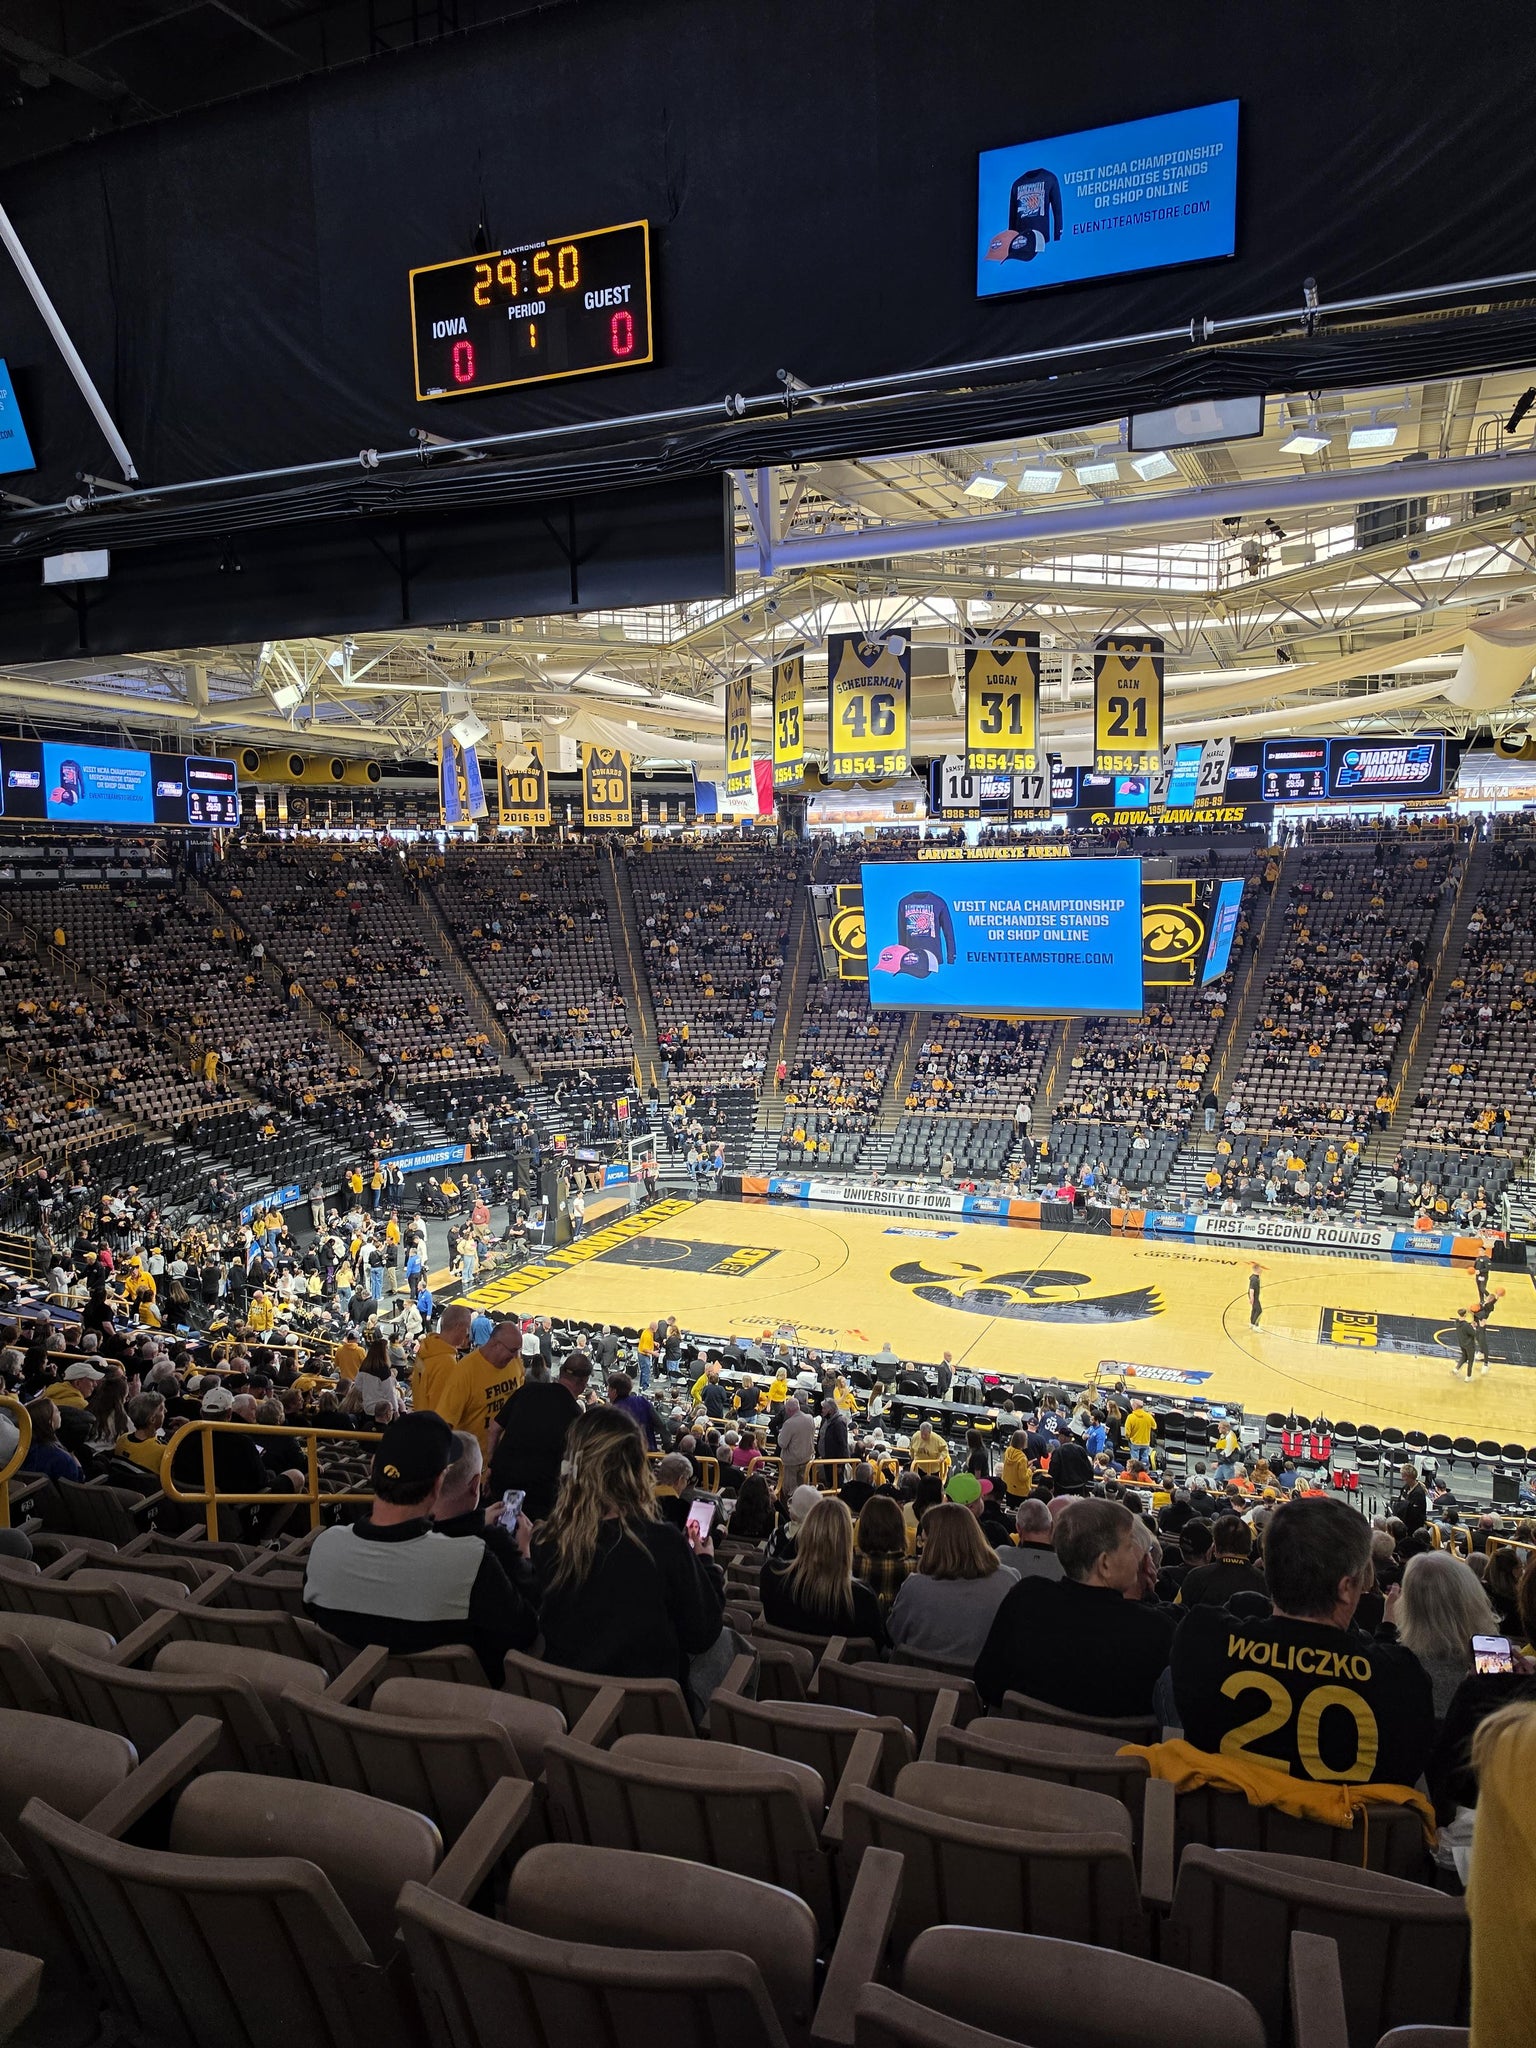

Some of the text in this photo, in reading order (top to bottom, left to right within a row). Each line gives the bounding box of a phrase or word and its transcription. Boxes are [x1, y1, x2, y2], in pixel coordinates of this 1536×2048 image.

[1063, 143, 1224, 185] VISIT NCAA CHAMPIONSHIP
[1077, 161, 1208, 197] MERCHANDISE STANDS
[1094, 180, 1189, 209] OR SHOP ONLINE
[502, 241, 546, 255] DAKTRONICS
[474, 245, 579, 306] 29:50
[584, 284, 631, 310] GUEST
[508, 300, 546, 320] PERIOD
[432, 316, 467, 339] IOWA
[529, 323, 536, 348] 1
[612, 311, 633, 354] 0
[453, 340, 474, 382] 0
[836, 676, 904, 694] SCHEUERMAN
[986, 674, 1018, 686] LOGAN
[1117, 679, 1140, 689] CAIN
[842, 693, 895, 738] 46
[980, 692, 1022, 734] 31
[1107, 696, 1147, 737] 21
[778, 706, 800, 749] 33
[730, 722, 749, 761] 22
[833, 755, 907, 775] 1954-56
[968, 753, 1036, 770] 1954-56
[1097, 755, 1160, 771] 1954-56
[1358, 750, 1408, 766] MARCH
[591, 768, 622, 777] EDWARDS
[1199, 760, 1225, 787] 23
[1363, 762, 1430, 778] MADNESS
[508, 777, 539, 803] 10
[591, 778, 624, 803] 30
[949, 775, 973, 798] 10
[1020, 776, 1044, 799] 17
[1193, 795, 1223, 808] 1986-89
[503, 813, 546, 822] 2016-19
[587, 813, 630, 823] 1985-88
[942, 809, 980, 819] 1986-89
[1112, 811, 1154, 825] IOWA
[1158, 807, 1244, 824] HAWKEYES
[917, 845, 1071, 860] CARVER-HAWKEYE ARENA
[953, 899, 1125, 912] VISIT NCAA CHAMPIONSHIP
[968, 914, 1109, 926] MERCHANDISE STANDS
[988, 929, 1089, 941] OR SHOP ONLINE
[966, 951, 1113, 964] EVENT1TEAMSTORE.COM
[413, 1152, 450, 1166] MADNESS
[843, 1188, 905, 1204] UNIVERSITY
[906, 1194, 922, 1205] OF
[923, 1195, 951, 1208] IOWA
[1206, 1218, 1245, 1233] FIRST
[1257, 1222, 1312, 1240] SECOND
[1316, 1229, 1382, 1246] ROUNDS
[452, 1198, 697, 1309] IOWA HAWKEYES
[1413, 1242, 1440, 1250] MADNESS
[485, 1376, 518, 1400] FROM
[486, 1398, 505, 1413] THE
[1222, 1557, 1245, 1565] IOWA
[1227, 1634, 1372, 1681] WOLICZKO
[1219, 1670, 1379, 1782] 20
